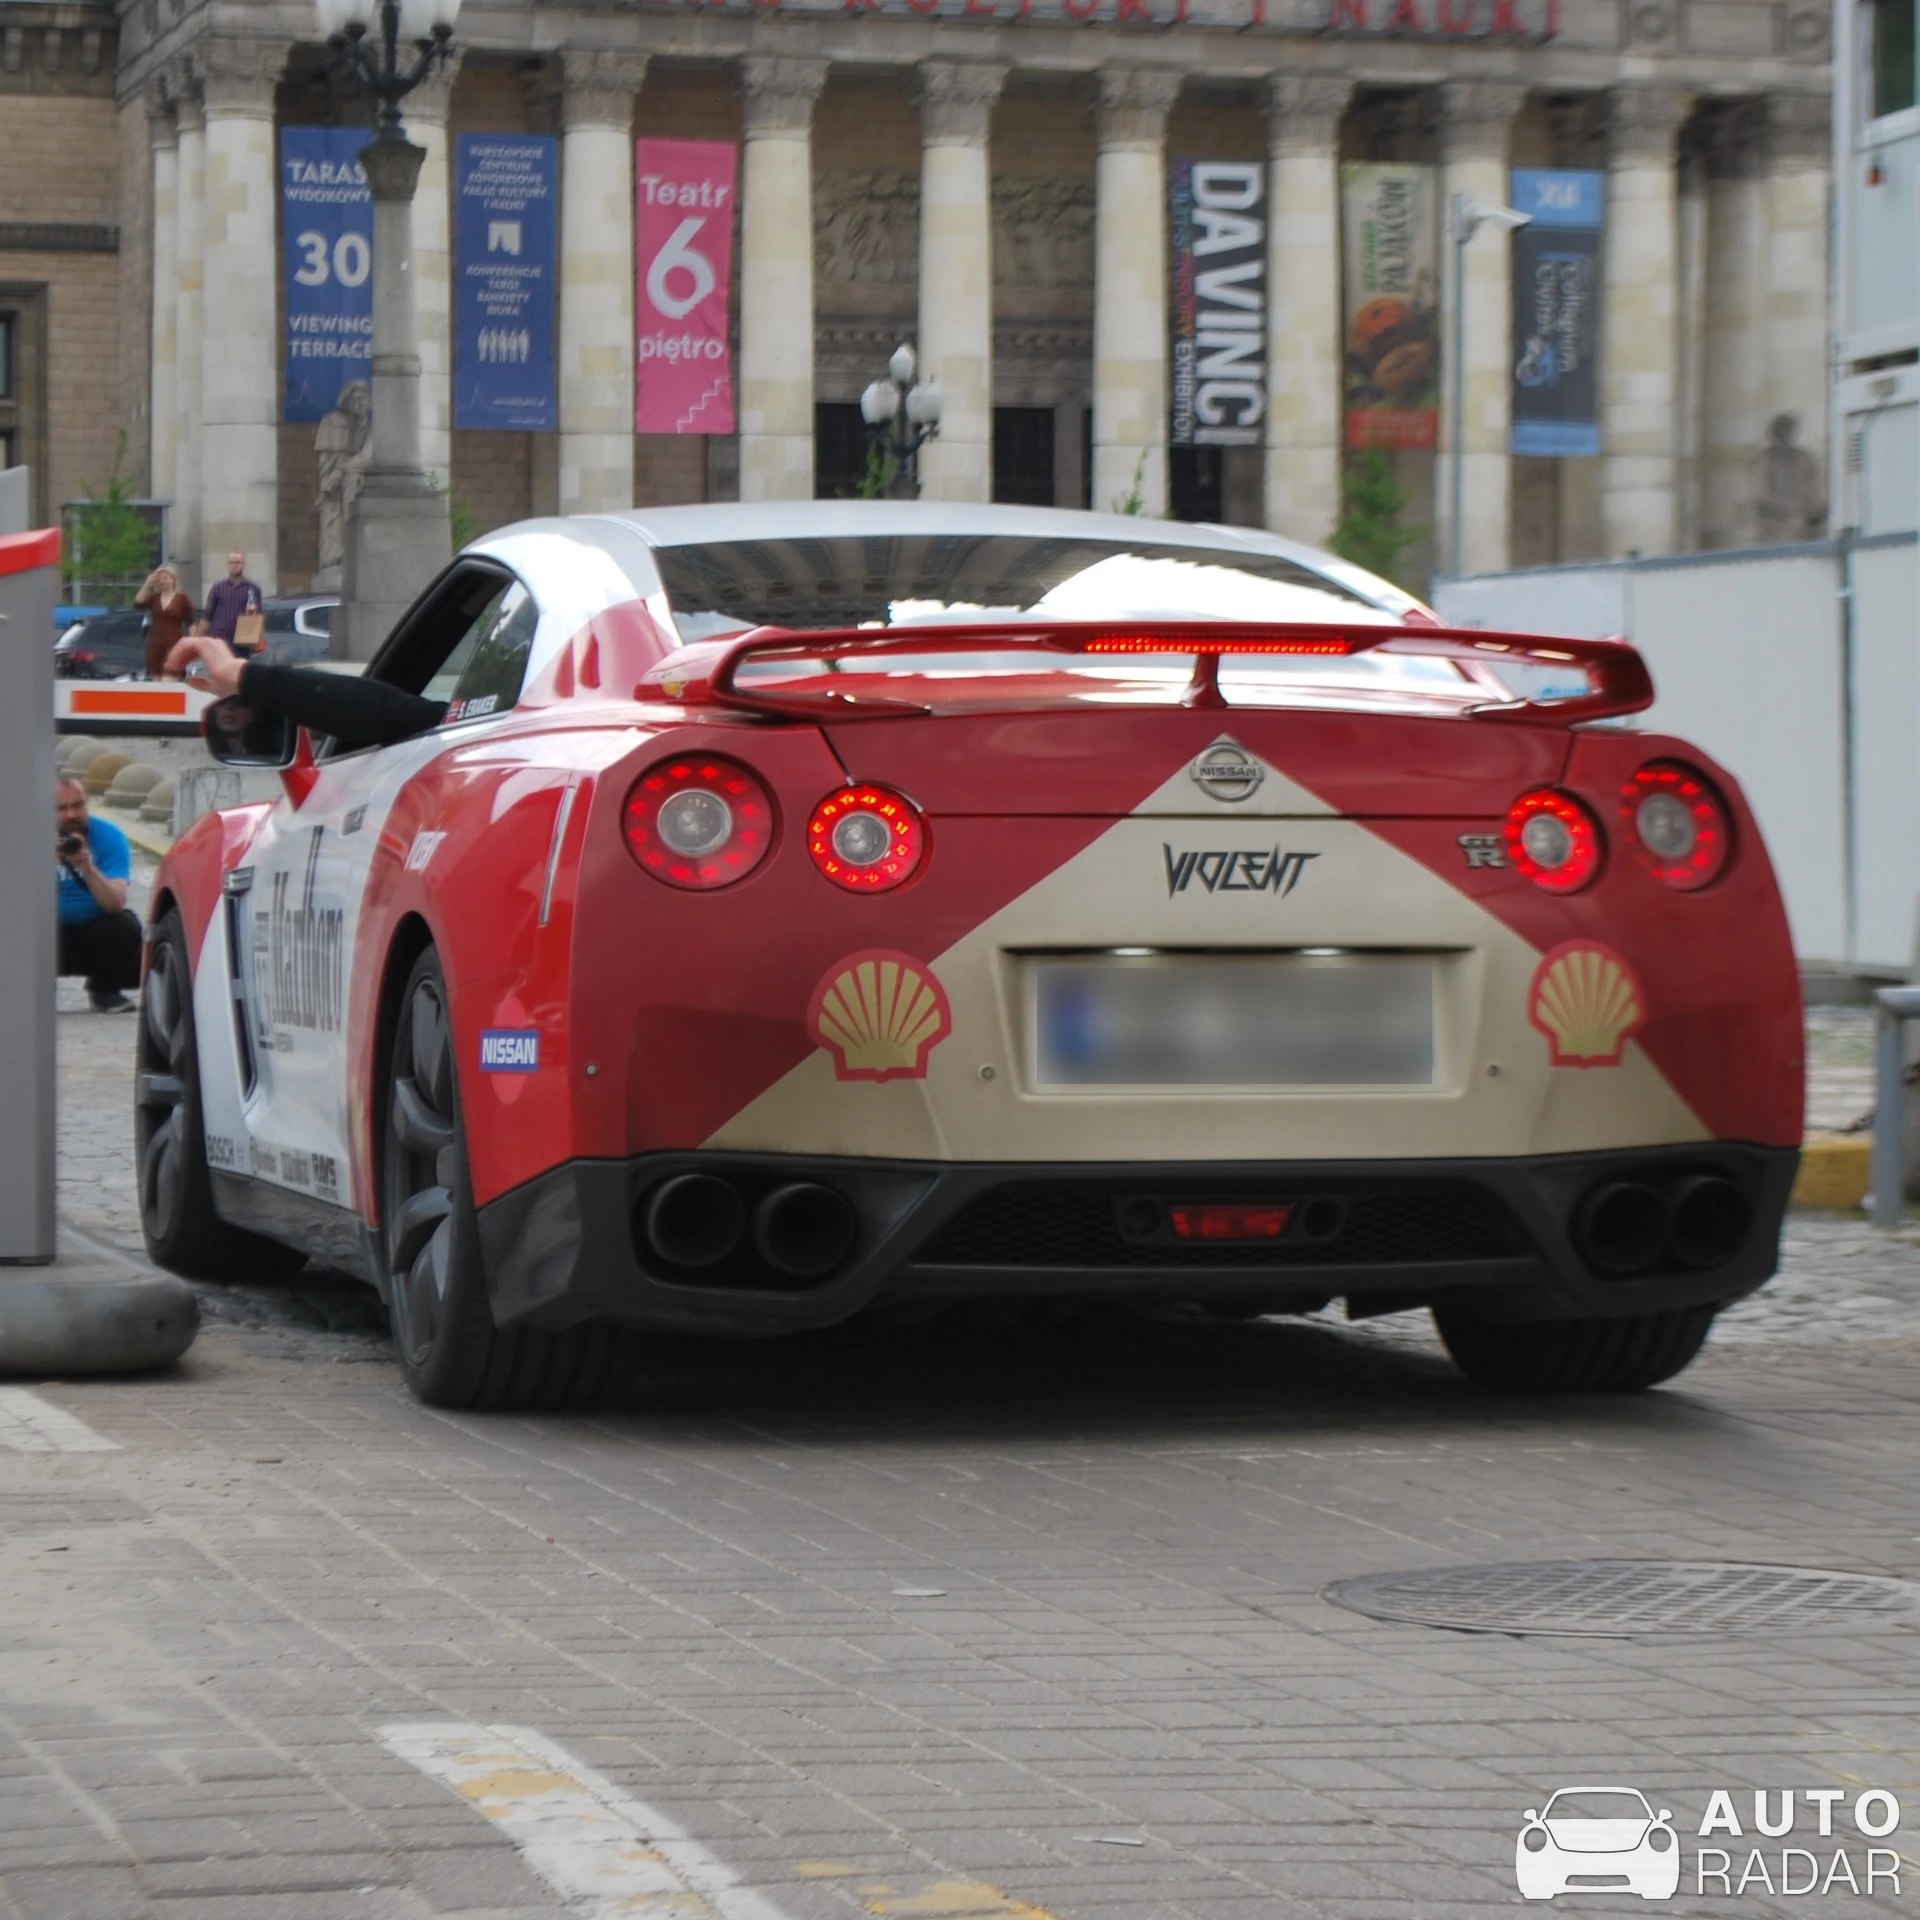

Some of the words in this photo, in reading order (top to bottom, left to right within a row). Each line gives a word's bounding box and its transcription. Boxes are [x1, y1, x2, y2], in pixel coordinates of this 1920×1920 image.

[286, 159, 367, 185] TARAS
[479, 160, 533, 171] CENTRUM
[467, 172, 543, 185] KONGRESOWE
[284, 186, 370, 204] WIDOKOWY
[498, 186, 548, 199] KULTURY
[640, 174, 729, 208] Teatr
[294, 230, 371, 288] 30
[466, 264, 542, 278] KONFERENCJE
[646, 215, 716, 321] 6
[487, 279, 519, 290] TARGI
[477, 291, 531, 304] BANKIETY
[487, 305, 519, 316] BIURA
[288, 313, 373, 335] VIEWING
[288, 338, 373, 360] TERRACE
[639, 331, 724, 364] piętro
[1173, 341, 1192, 444] EXHIBITION
[1200, 766, 1257, 777] NISSAN
[1162, 842, 1322, 899] VIOLENT
[271, 825, 344, 1036] Marlboro
[482, 1037, 536, 1065] NISSAN
[207, 1135, 235, 1166] BOSCH
[312, 1152, 337, 1187] RAYS
